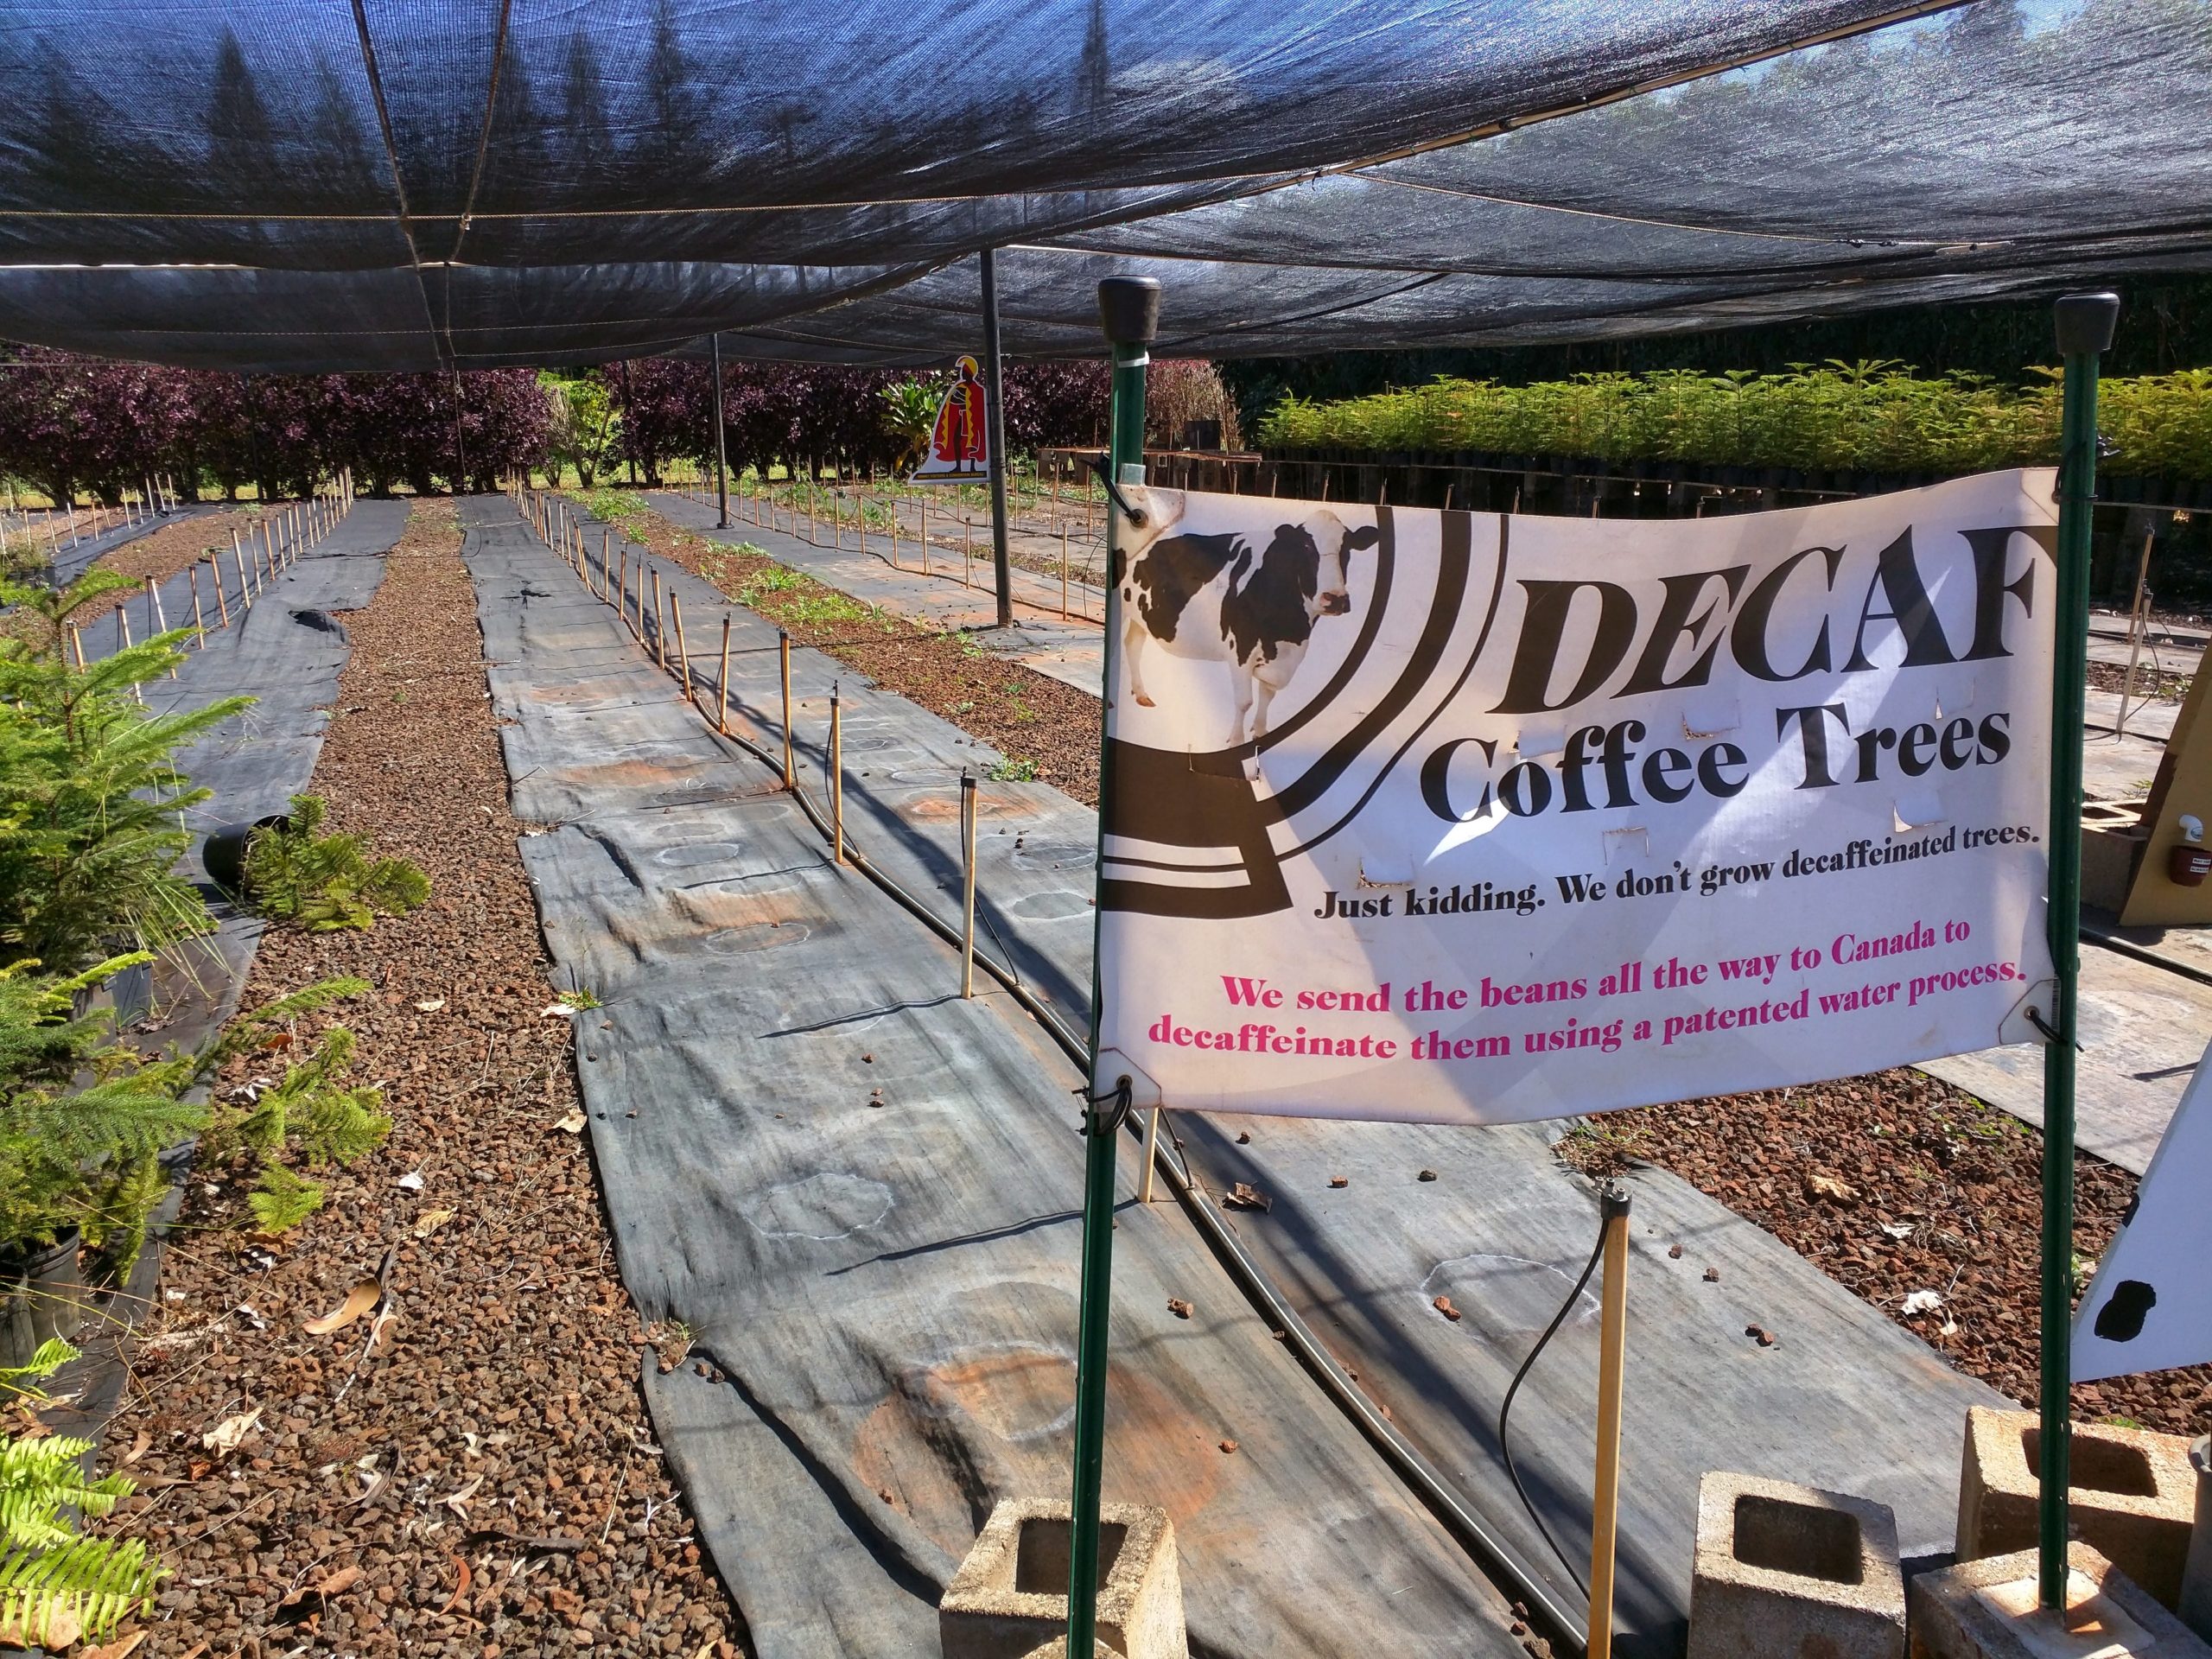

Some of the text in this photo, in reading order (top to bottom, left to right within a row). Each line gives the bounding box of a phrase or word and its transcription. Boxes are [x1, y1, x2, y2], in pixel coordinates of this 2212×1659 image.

[1484, 522, 2059, 715] DECAF
[1419, 702, 2012, 823] Coffee Trees
[1313, 824, 2040, 919] Just kidding. We don't grow decaffeinated trees.
[1147, 959, 2027, 1061] decaffeinate them using a patented water process.
[1220, 918, 1971, 1013] We send the beans all the way to Canada to
